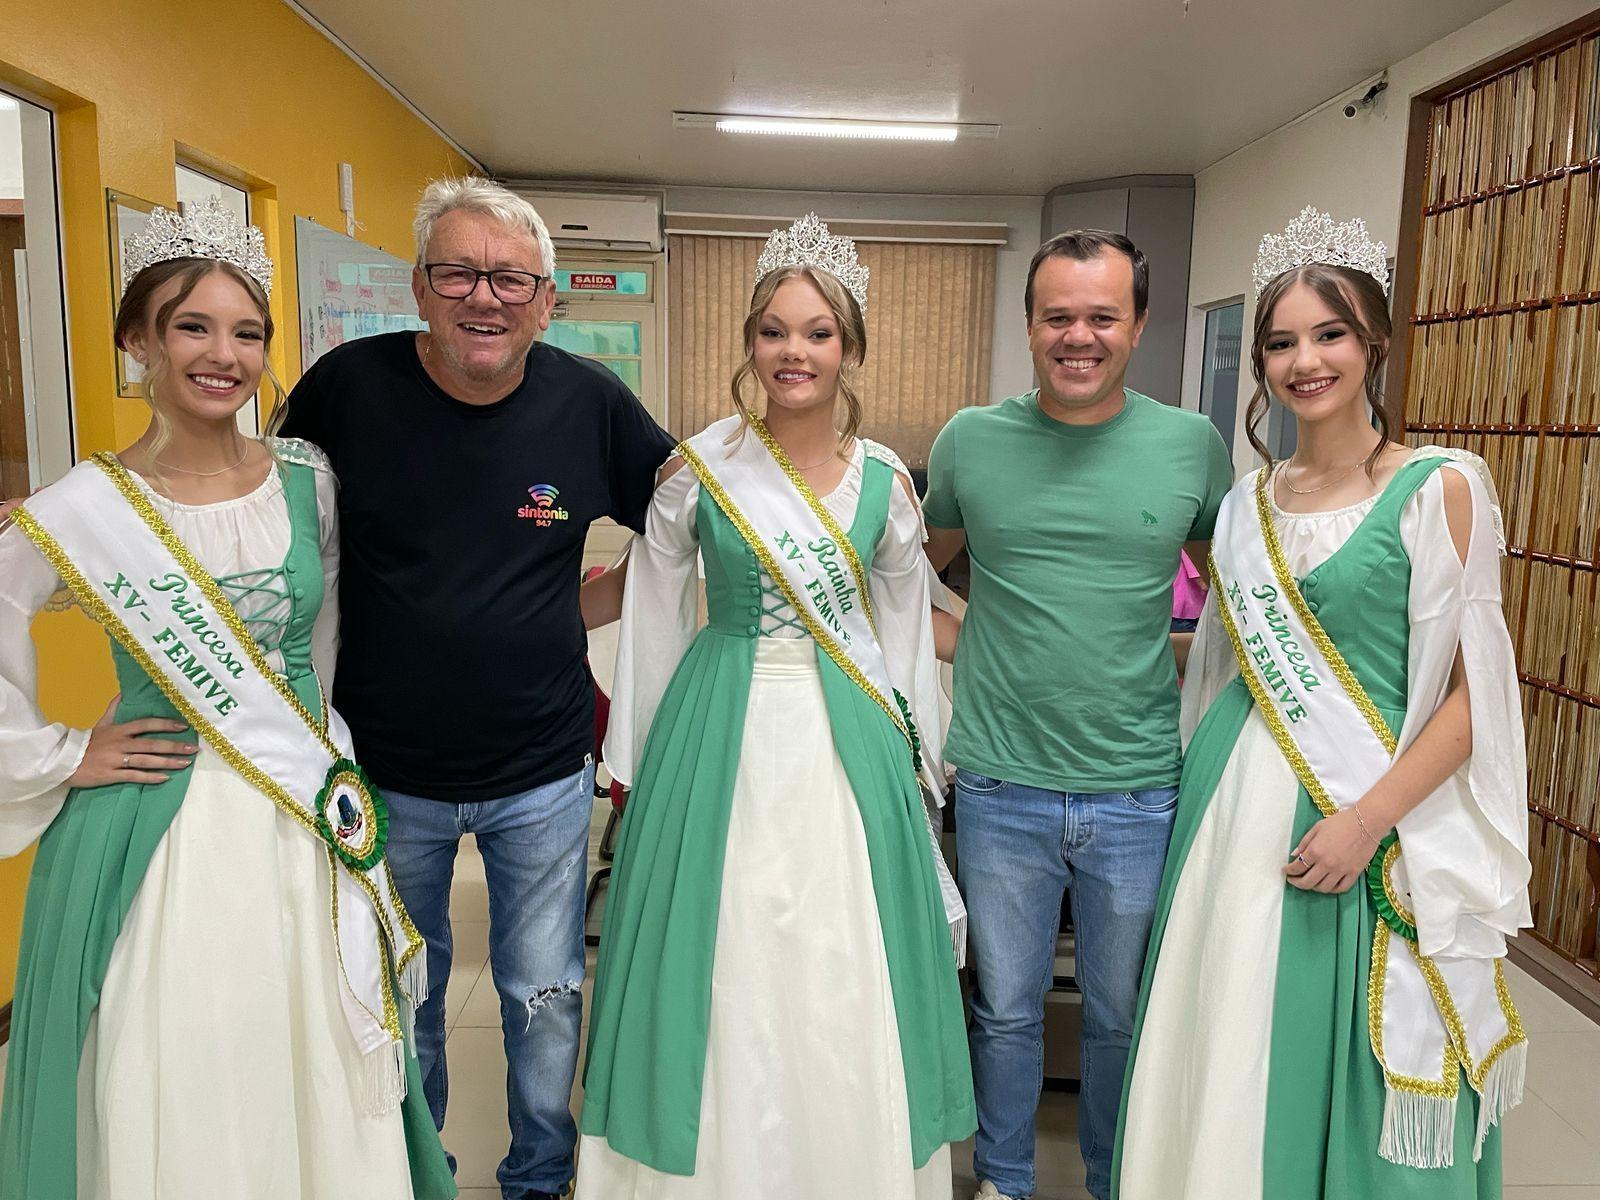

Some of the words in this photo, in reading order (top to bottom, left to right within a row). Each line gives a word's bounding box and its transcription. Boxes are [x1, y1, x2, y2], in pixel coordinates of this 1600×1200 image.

[575, 275, 613, 284] SAÍDA
[517, 504, 569, 520] sintonia
[535, 519, 552, 528] 94.7
[804, 578, 852, 646] FEMIVE
[807, 536, 857, 615] Rainha
[149, 572, 246, 680] Princesa
[1251, 584, 1321, 692] Princesa
[152, 627, 239, 717] FEMIVE
[1246, 632, 1308, 724] FEMIVE
